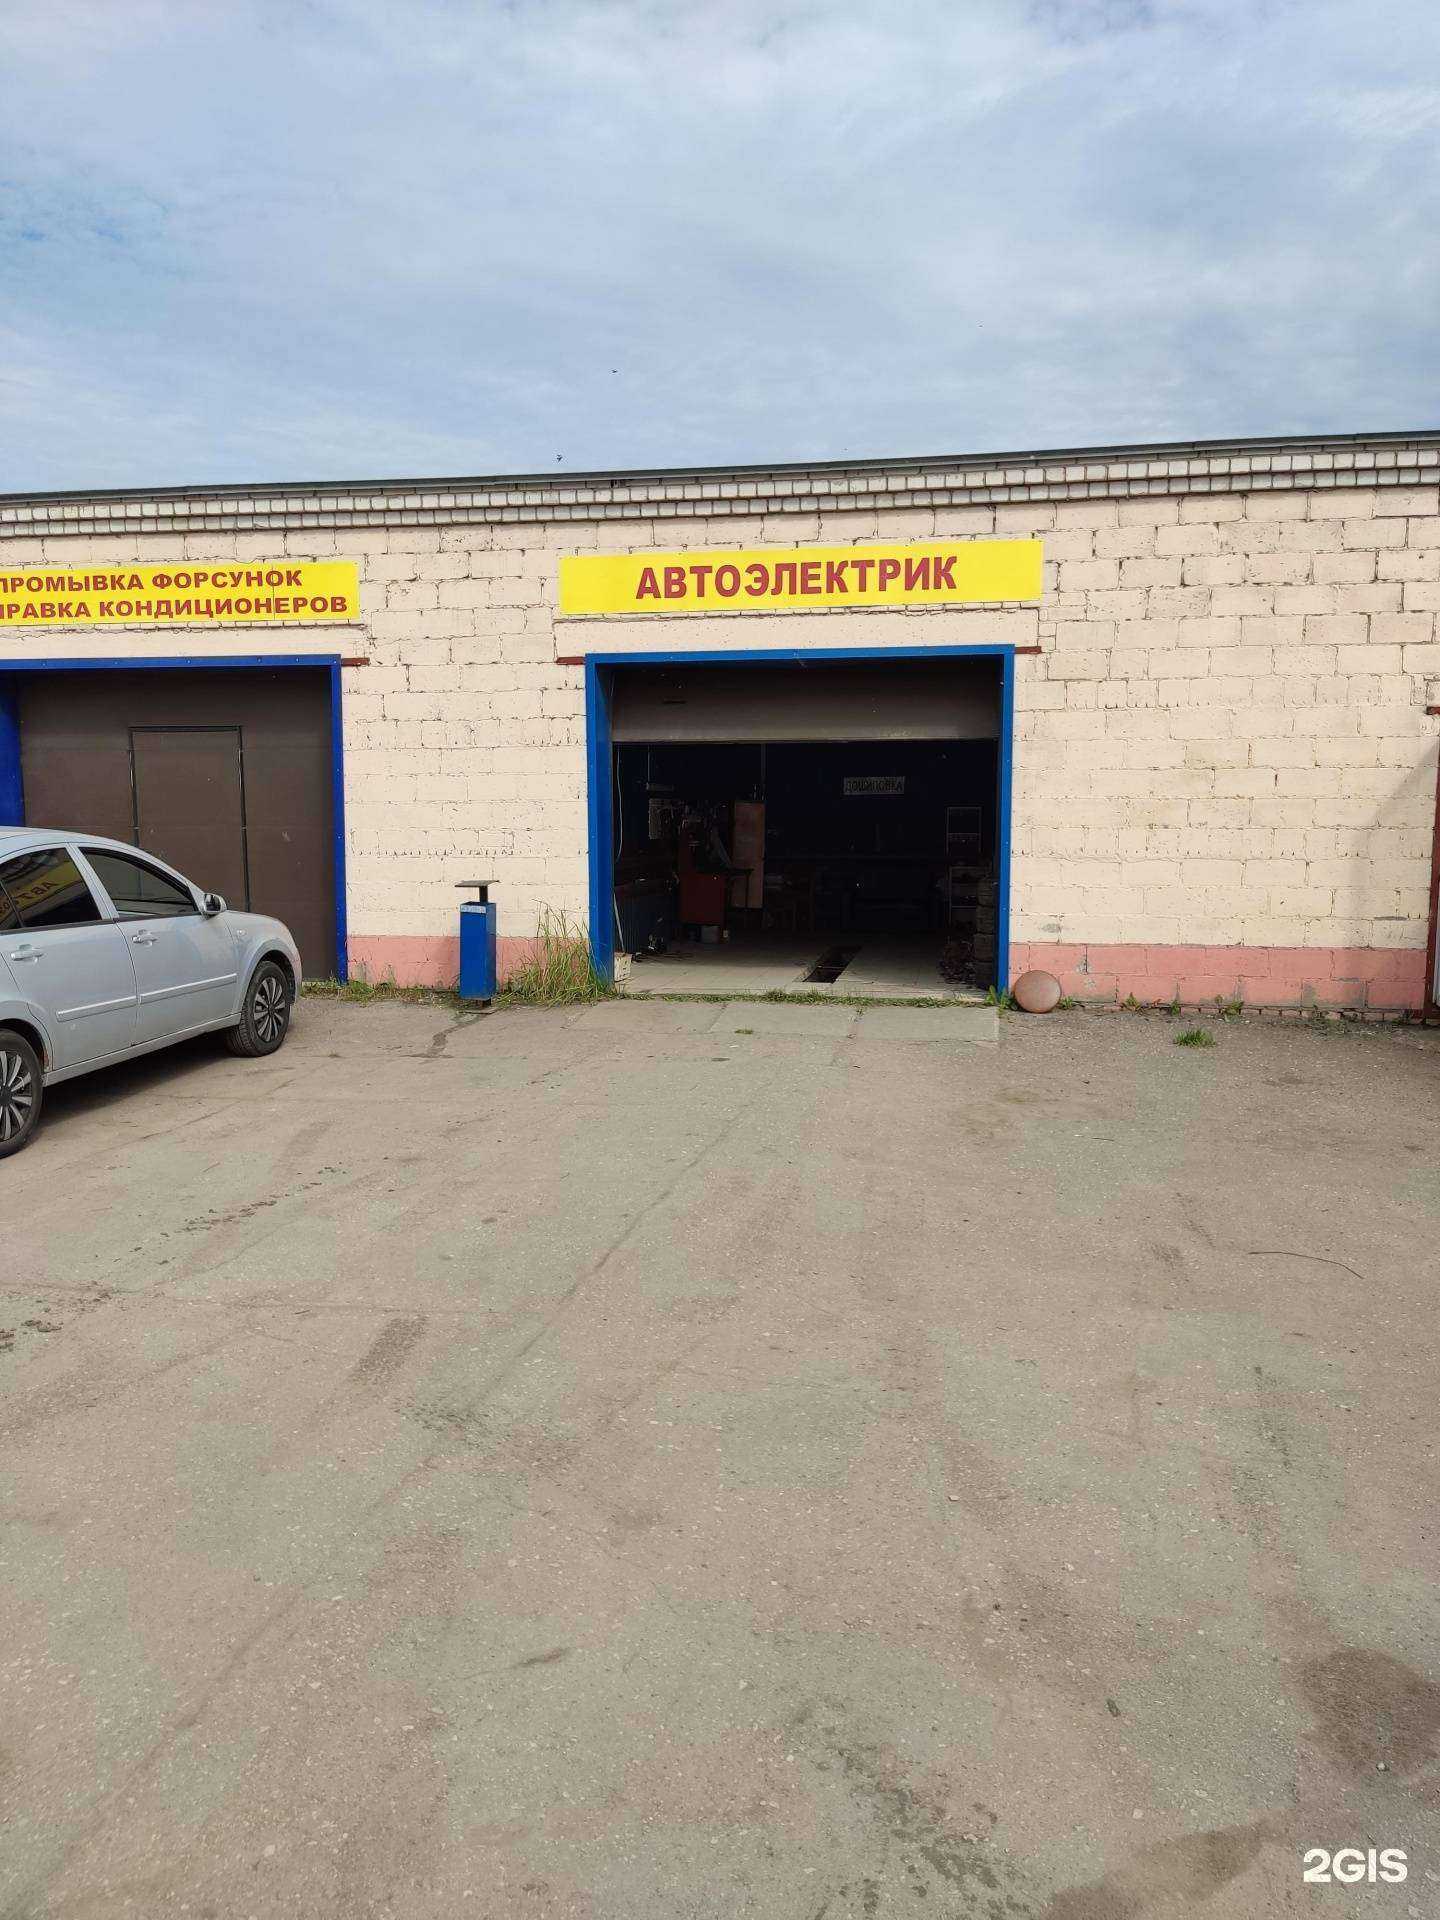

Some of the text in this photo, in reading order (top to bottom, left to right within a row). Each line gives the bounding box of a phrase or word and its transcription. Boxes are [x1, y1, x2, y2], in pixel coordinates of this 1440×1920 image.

[152, 569, 302, 588] ФОРСУНОК
[635, 556, 958, 599] АВТОЭЛЕКТРИК
[0, 597, 348, 619] РАВКА КОНДИЦИОНЕРОВ
